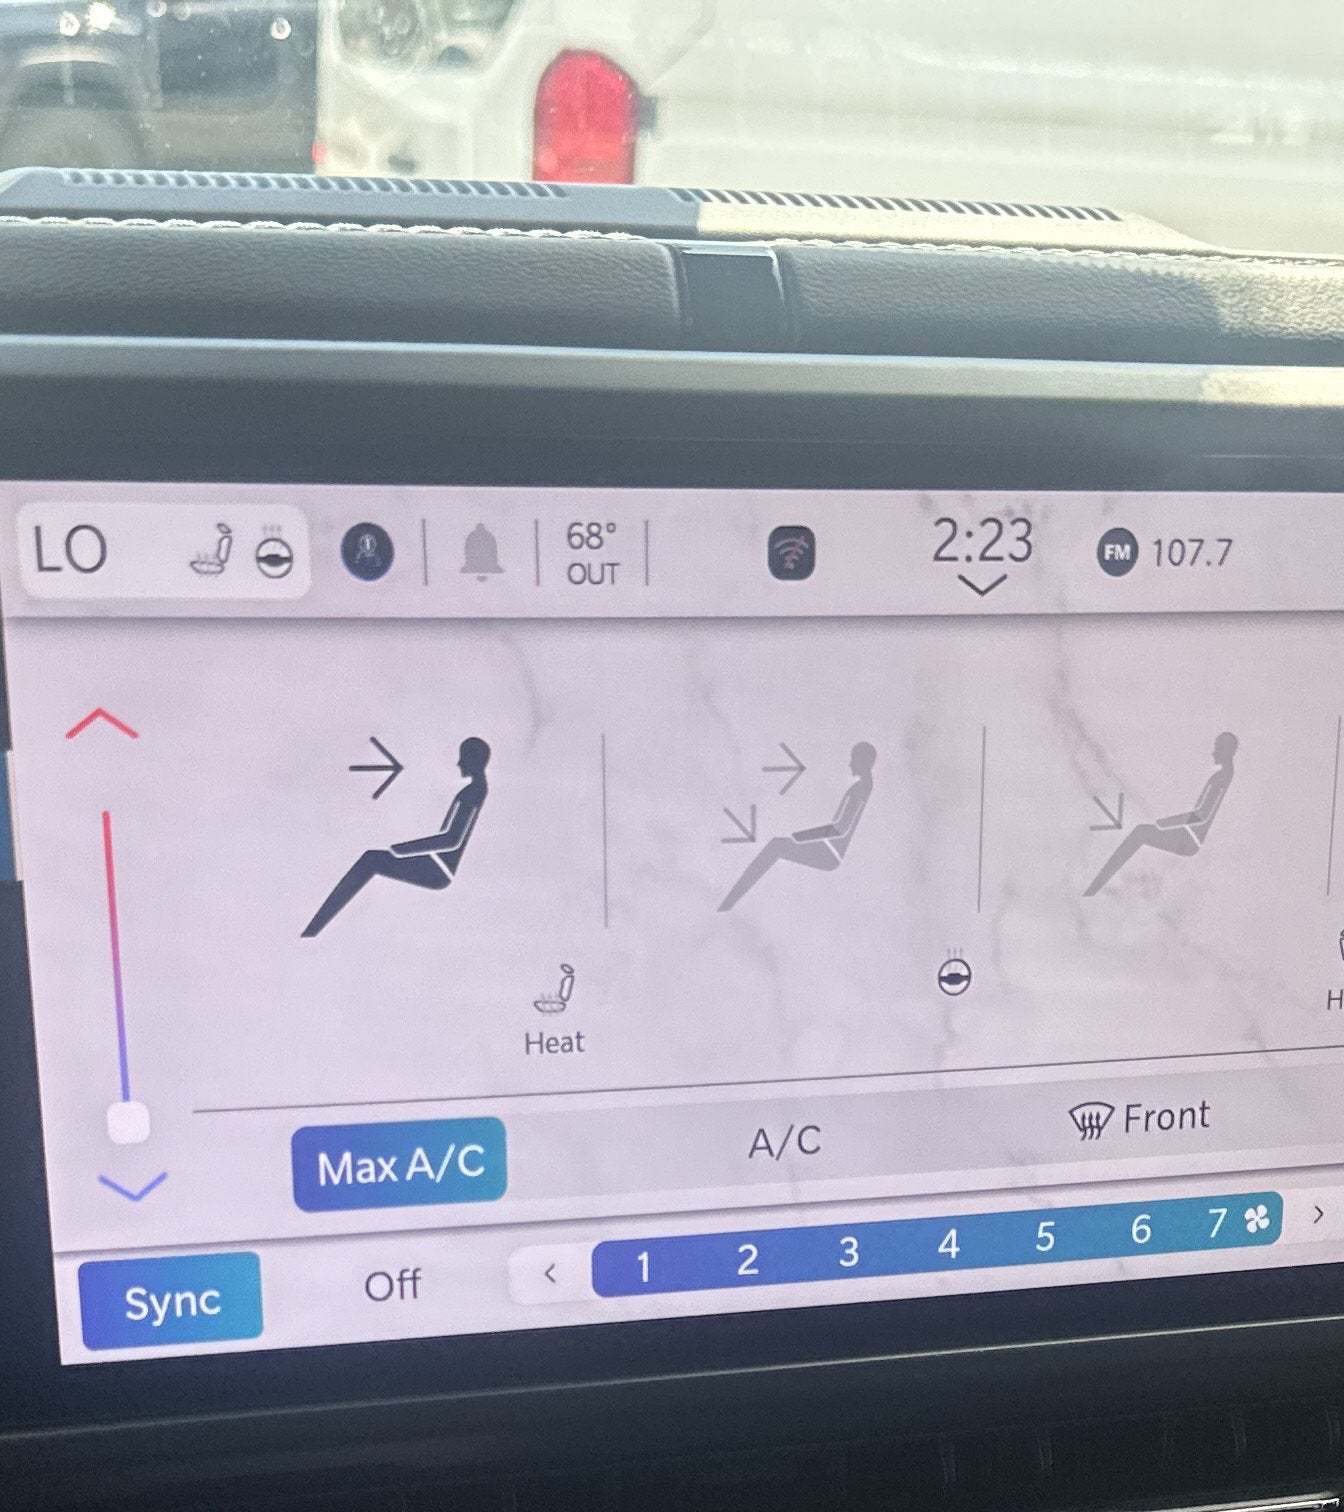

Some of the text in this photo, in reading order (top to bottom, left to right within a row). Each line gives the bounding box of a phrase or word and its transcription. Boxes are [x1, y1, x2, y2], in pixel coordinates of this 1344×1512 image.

[33, 523, 108, 574] LO
[565, 521, 617, 551] 68°
[931, 516, 1034, 564] 2:23
[1103, 543, 1132, 562] FM
[1152, 538, 1234, 569] 107.7
[566, 561, 620, 587] OUT
[523, 1029, 586, 1056] Heat
[1124, 1099, 1212, 1134] Front
[748, 1123, 823, 1162] A/C
[317, 1142, 487, 1187] Max A/C
[637, 1208, 1228, 1283] 1 2 3 4 5 6 7
[364, 1267, 423, 1303] Off
[124, 1280, 223, 1327] Sync
